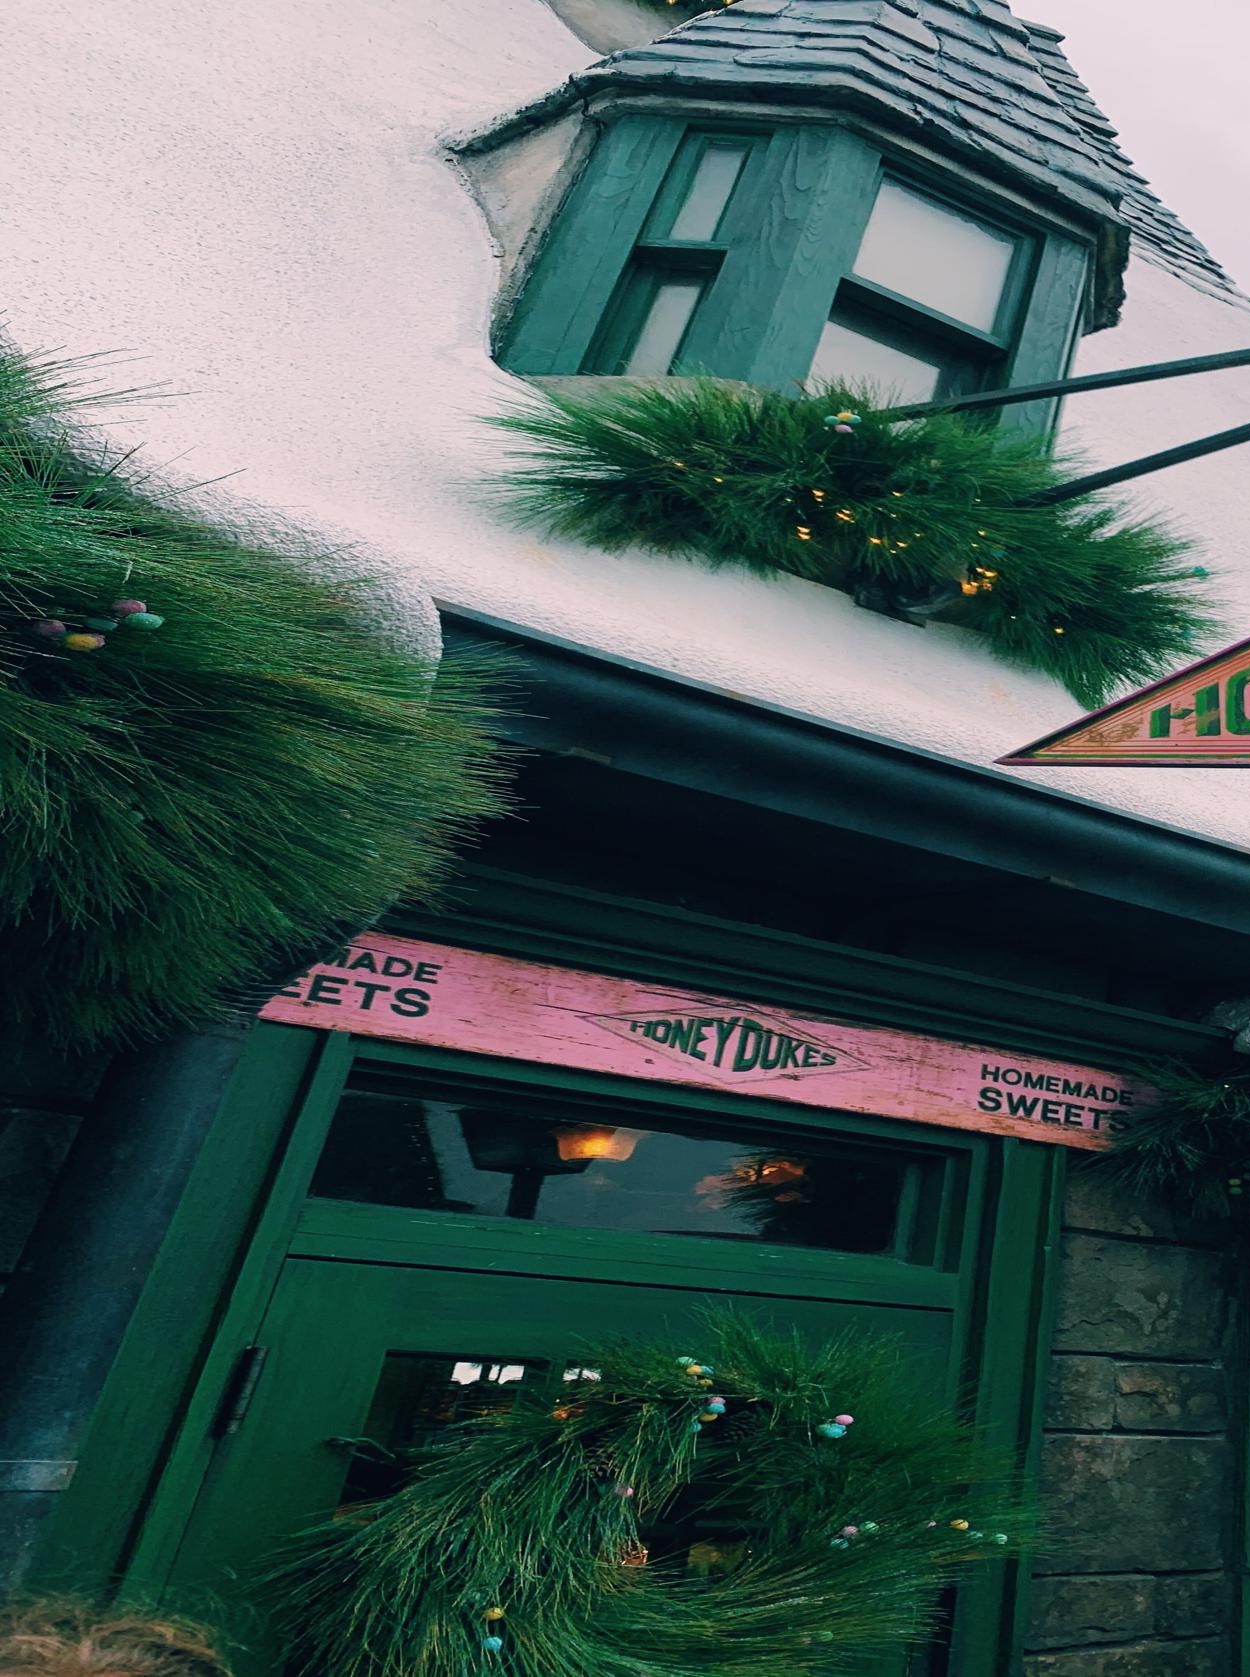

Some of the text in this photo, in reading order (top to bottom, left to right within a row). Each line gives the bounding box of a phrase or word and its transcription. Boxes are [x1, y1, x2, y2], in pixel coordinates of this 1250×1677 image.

[630, 1016, 837, 1073] HONEYDUKES
[980, 1064, 1134, 1106] HOMEMADE
[977, 1086, 1132, 1132] SWEETS
